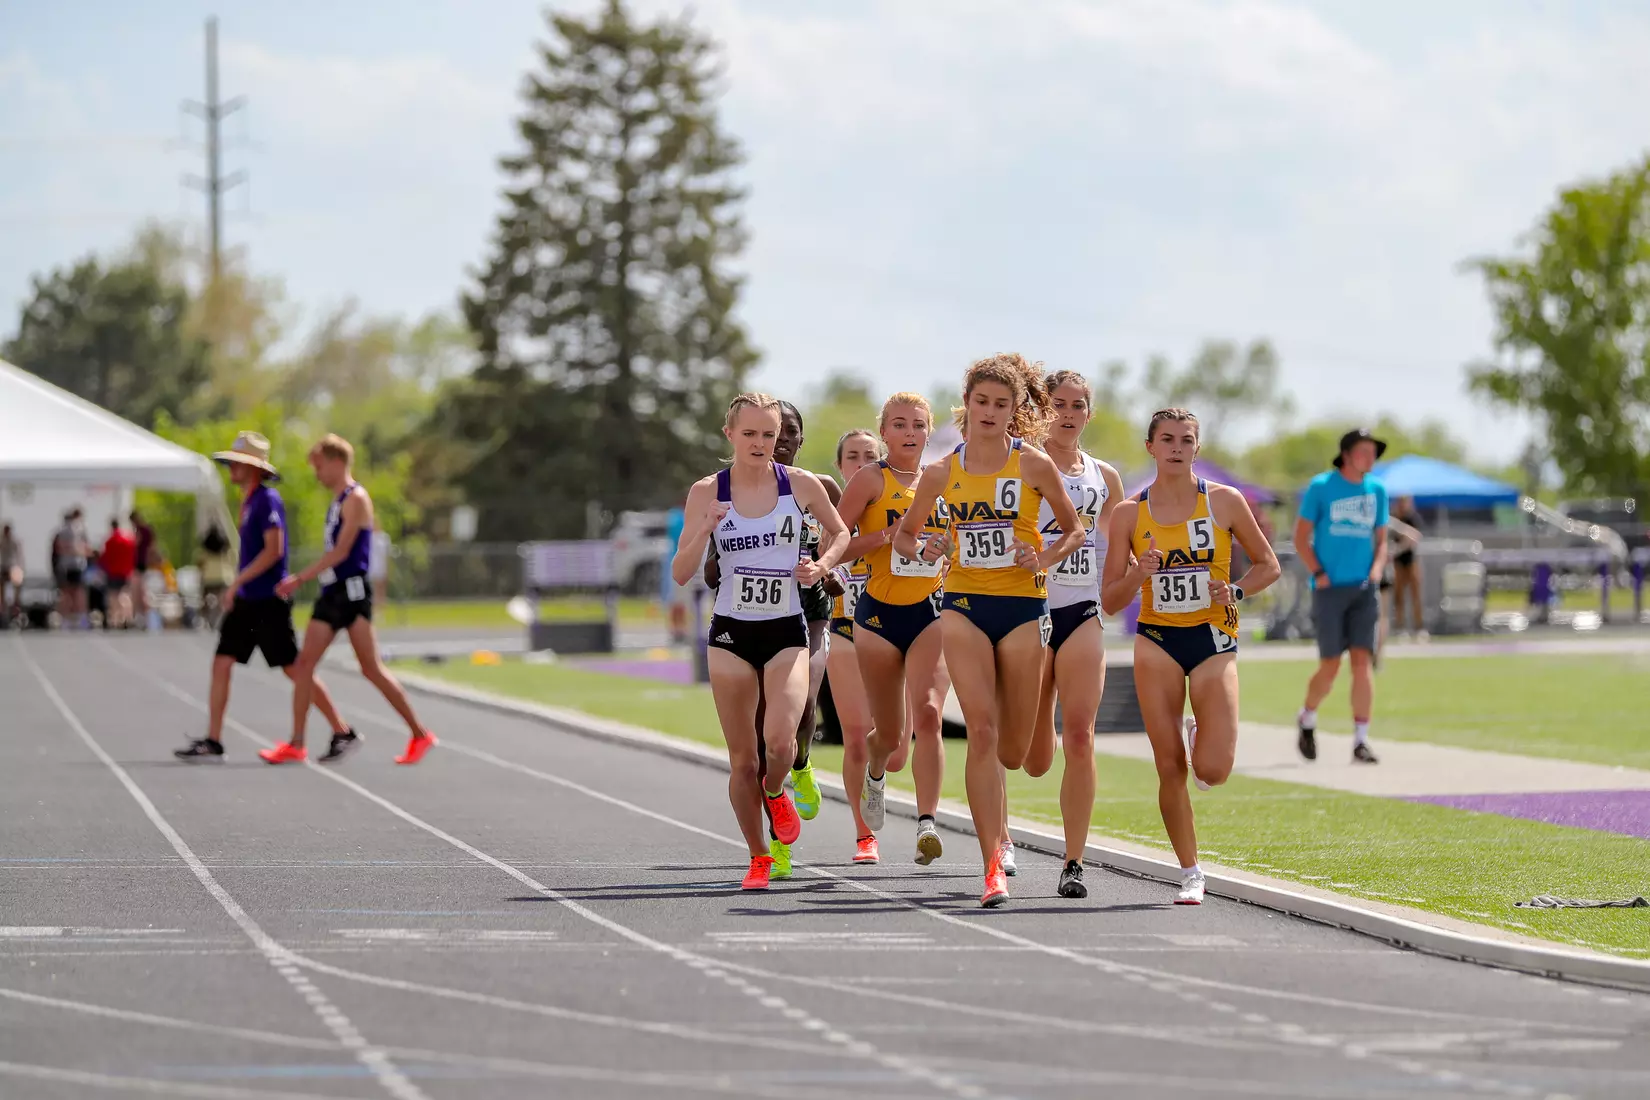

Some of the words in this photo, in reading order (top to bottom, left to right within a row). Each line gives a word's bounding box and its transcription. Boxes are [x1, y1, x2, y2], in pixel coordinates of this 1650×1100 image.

[1001, 480, 1016, 509] 6
[1086, 487, 1097, 515] 2
[720, 535, 760, 552] WEBER
[763, 532, 778, 547] ST
[780, 516, 795, 543] 4
[1194, 520, 1210, 548] 5
[966, 530, 1006, 558] 359
[1057, 549, 1090, 575] 295
[741, 577, 782, 605] 536
[1160, 575, 1200, 602] 351
